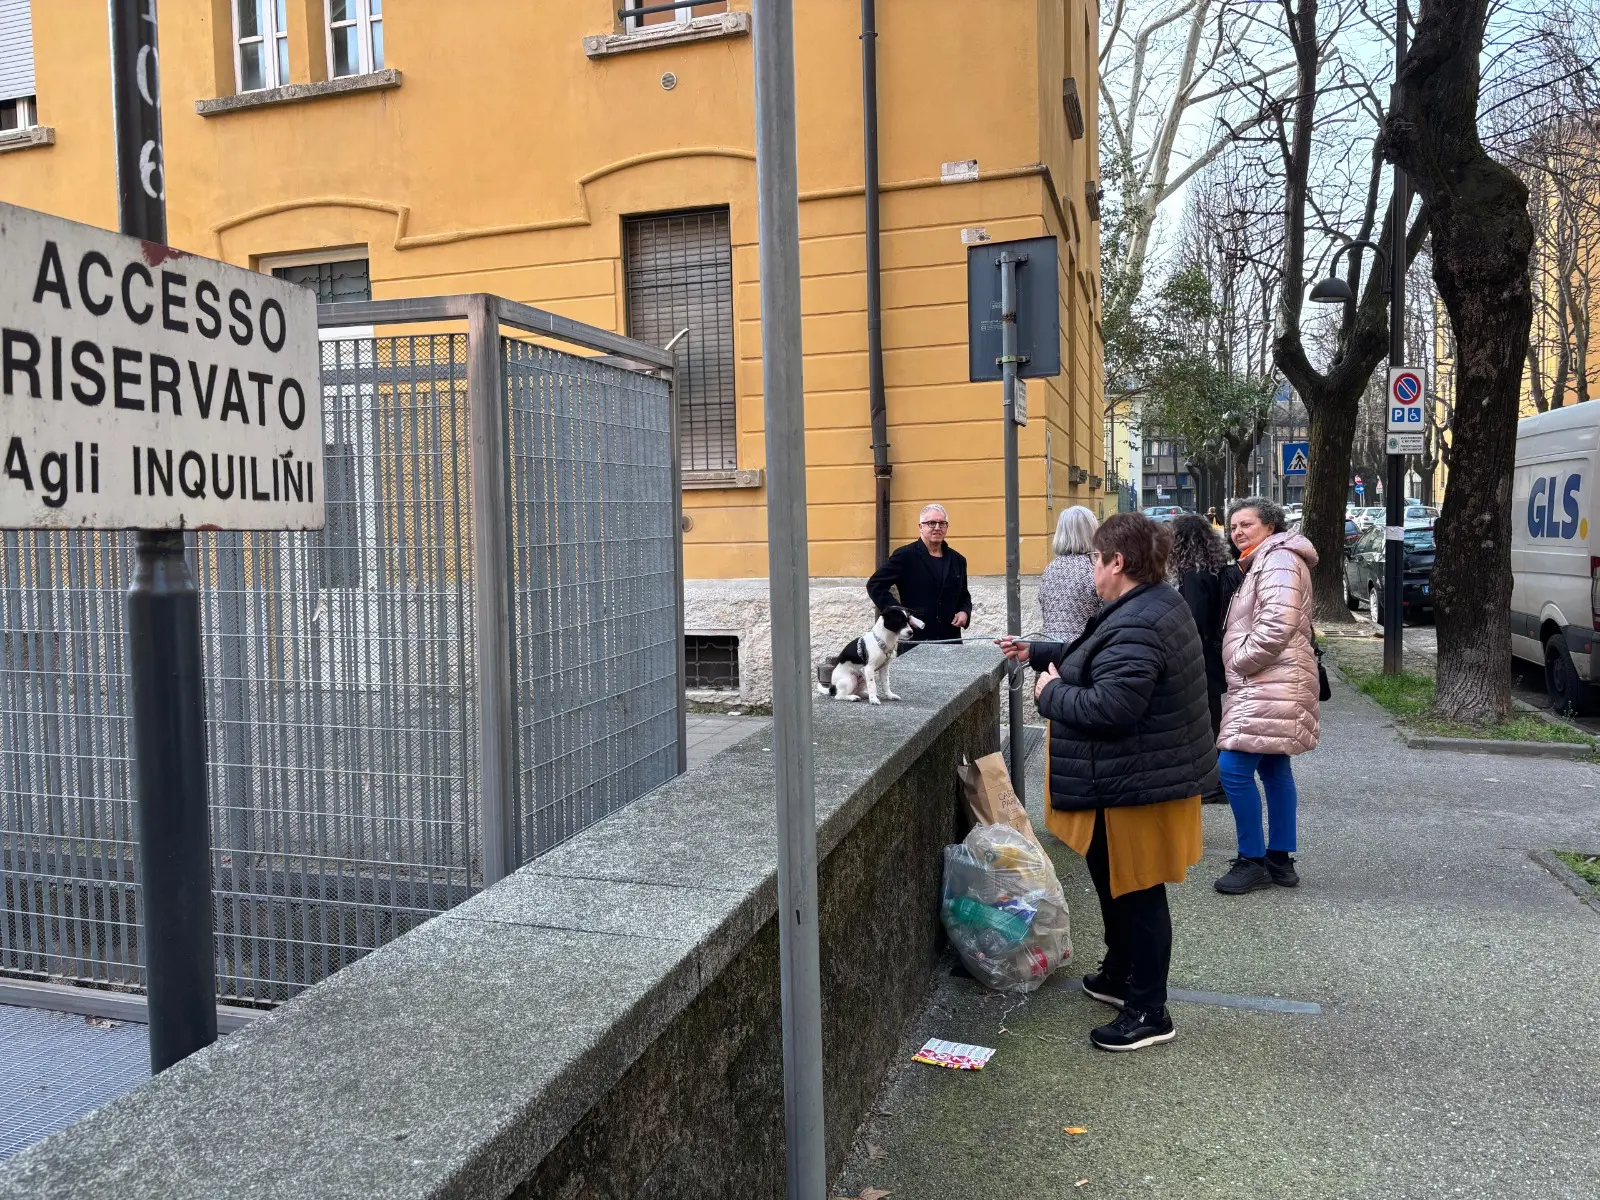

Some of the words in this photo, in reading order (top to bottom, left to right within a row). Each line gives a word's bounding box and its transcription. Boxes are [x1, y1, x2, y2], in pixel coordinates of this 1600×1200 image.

[32, 240, 287, 353] ACCESSO
[2, 328, 306, 430] RISERVATO
[1394, 409, 1403, 421] P
[4, 436, 99, 508] Agli
[133, 446, 313, 503] INQUILINI
[1528, 473, 1581, 539] GLS
